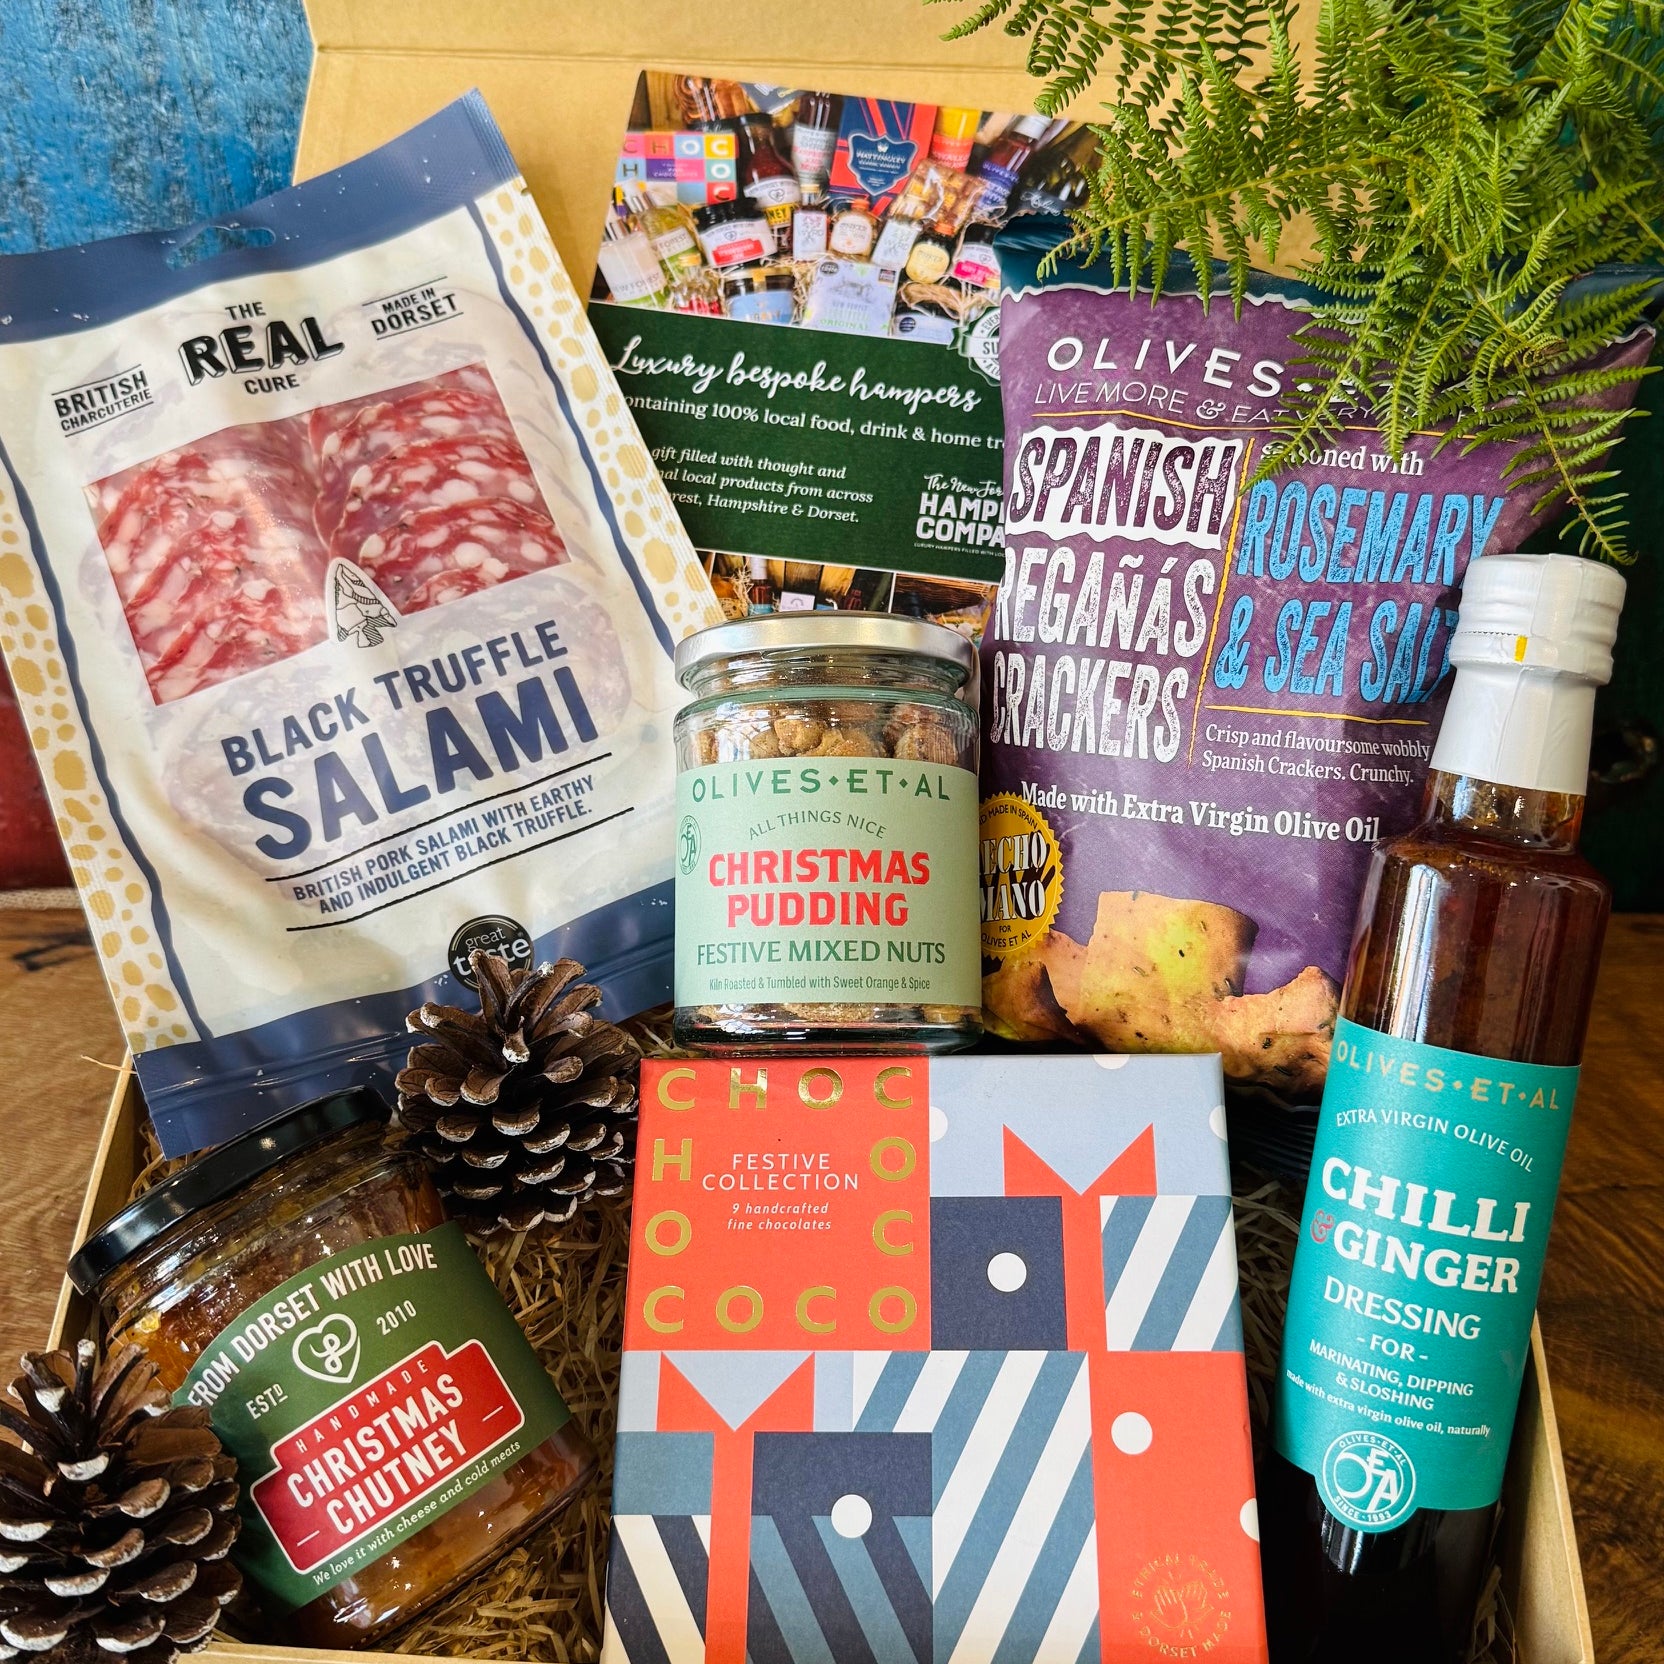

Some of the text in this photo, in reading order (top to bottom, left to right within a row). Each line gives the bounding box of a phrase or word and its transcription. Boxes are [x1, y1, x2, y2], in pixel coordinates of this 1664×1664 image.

[225, 301, 266, 322] THE
[370, 294, 458, 336] DORSET
[382, 288, 435, 314] MADE IN
[179, 317, 345, 386] REAL
[1047, 336, 1285, 397] OLIVES
[54, 370, 149, 418] BRITISH
[245, 374, 300, 395] CURE
[611, 335, 982, 415] Luxury bespoke hampers
[61, 389, 152, 431] CHARCUTERIE
[1035, 382, 1226, 419] LIVE MORE &
[712, 404, 982, 448] 100% local food, drink & home
[652, 447, 846, 479] gift filled with thought and
[924, 473, 949, 490] The
[682, 469, 873, 503] local products from across
[1010, 436, 1237, 535] SPANISH
[708, 493, 859, 523] Hampshire & Dorset.
[1237, 480, 1504, 588] ROSEMARY
[994, 547, 1215, 658] REGAÑÁS
[1214, 595, 1253, 690] &
[1265, 601, 1347, 696] SEA
[220, 620, 567, 776] BLACK TRUFFLE
[990, 650, 1188, 763] CRACKERS
[242, 666, 598, 860] SALAMI
[1205, 724, 1430, 762] Crisp and flavoursome wobbly
[692, 769, 950, 802] OLIVES ET AL
[1202, 750, 1413, 787] Spanish Crackers. Crunchy.
[749, 810, 886, 840] ALL THINGS NICE
[989, 805, 1037, 829] MADE IN SPAIN
[1022, 782, 1380, 842] Made with Extra Virgin Olive Oil
[293, 775, 595, 901] BRITISH PORK SALAMI WITH EARTHY
[320, 801, 592, 914] AND INDULGENT BLACK TRUFFLE.
[709, 849, 930, 887] CHRISTMAS
[727, 892, 909, 928] PUDDING
[999, 925, 1011, 933] FOR
[465, 927, 506, 952] great
[697, 940, 945, 965] FESTIVE MIXED NUTS
[981, 930, 1031, 947] OLIVES ET AL
[710, 976, 930, 991] Kiln Roasted & Tumbled with Sweet Orange & Spice
[1336, 1041, 1559, 1111] OLIVES ET AL
[1336, 1108, 1534, 1172] EXTRA VIRGIN OLIVE OIL
[702, 1173, 858, 1191] COLLECTION
[732, 1153, 830, 1170] FESTIVE
[732, 1203, 829, 1214] 9 handcrafted
[1322, 1157, 1531, 1243] CHILLI
[727, 1219, 831, 1231] fine chocolates
[1334, 1221, 1520, 1294] GINGER
[188, 1243, 438, 1406] FROM DORSET WITH LOVE
[376, 1300, 417, 1336] 2010
[1323, 1275, 1481, 1340] DRESSING
[1310, 1339, 1474, 1396] MARINATING, DIPPING
[296, 1360, 428, 1453] HANDMADE
[1287, 1370, 1491, 1436] made with extra virgin olive oil, naturally
[1335, 1372, 1434, 1410] & SLOSHING
[287, 1374, 463, 1508] CHRISTMAS
[1339, 1435, 1407, 1466] OLIVES ET AL
[326, 1421, 466, 1535] CHUTNEY
[313, 1441, 521, 1586] We love it with cheese and cold meats
[1334, 1495, 1391, 1522] SINCE 1993
